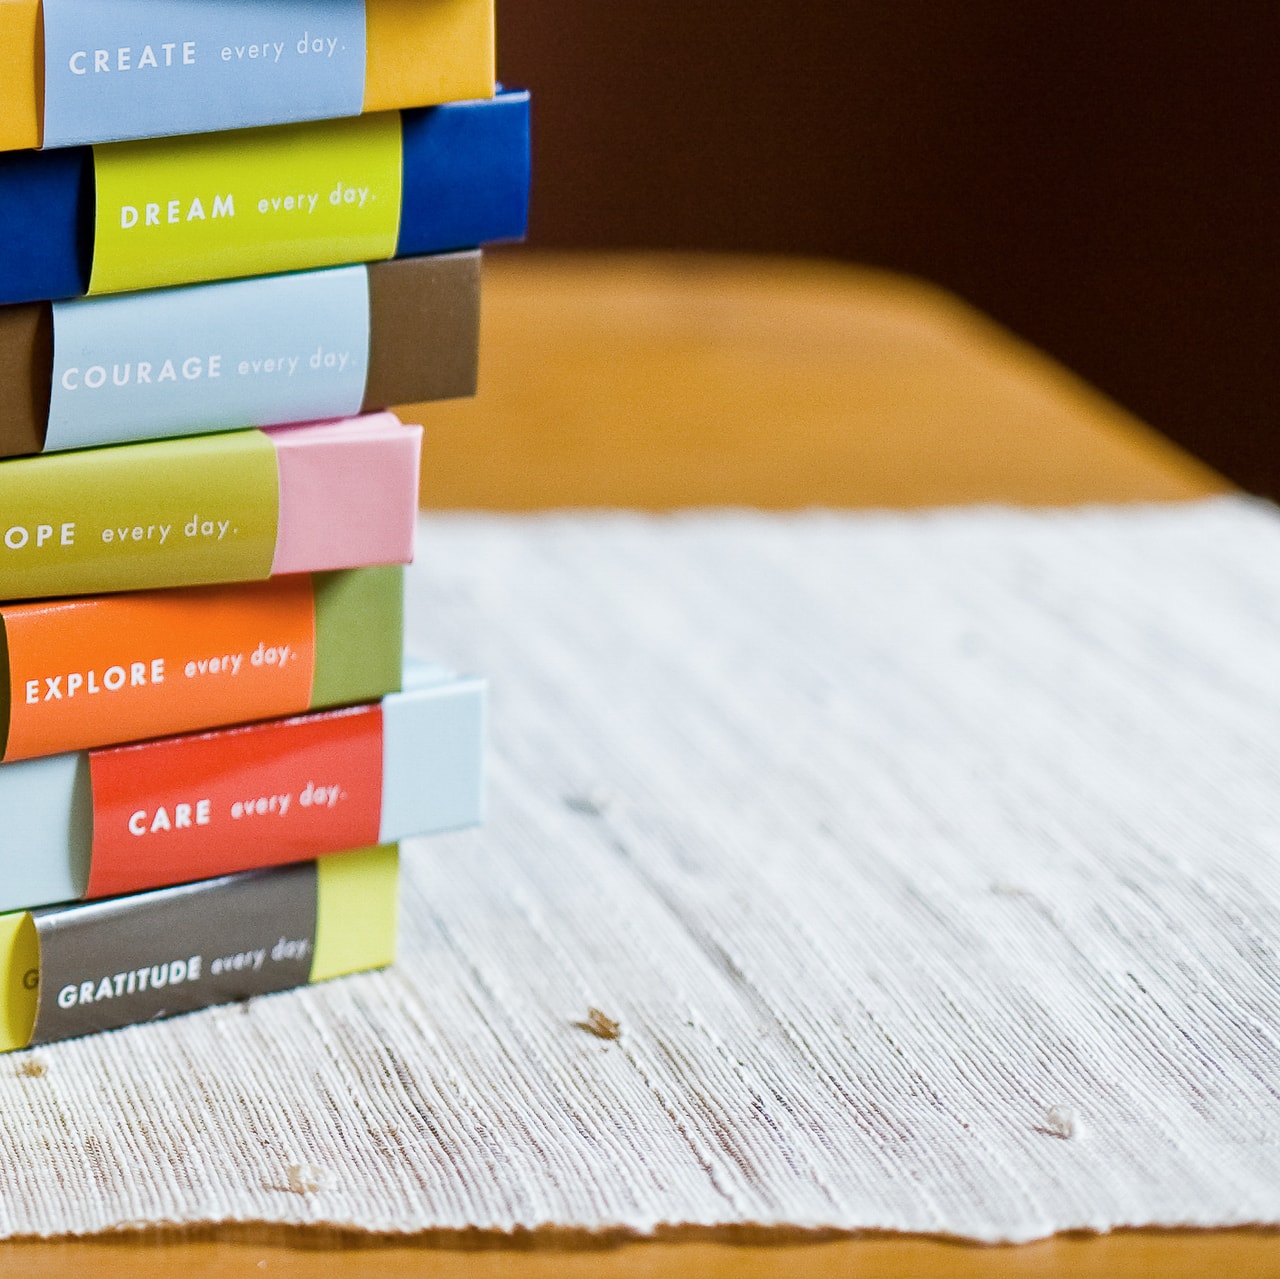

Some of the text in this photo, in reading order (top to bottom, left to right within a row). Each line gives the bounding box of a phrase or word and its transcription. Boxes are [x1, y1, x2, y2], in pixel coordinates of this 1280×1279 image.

[68, 31, 347, 76] CREATE every day.
[120, 181, 377, 229] DREAM every day.
[61, 345, 359, 392] COURAGE every day.
[101, 523, 172, 545] every
[184, 513, 239, 541] day.
[25, 641, 298, 705] EXPLORE every day.
[127, 780, 348, 837] CARE every day.
[56, 955, 203, 1010] GRATITUDE
[209, 945, 266, 977] every
